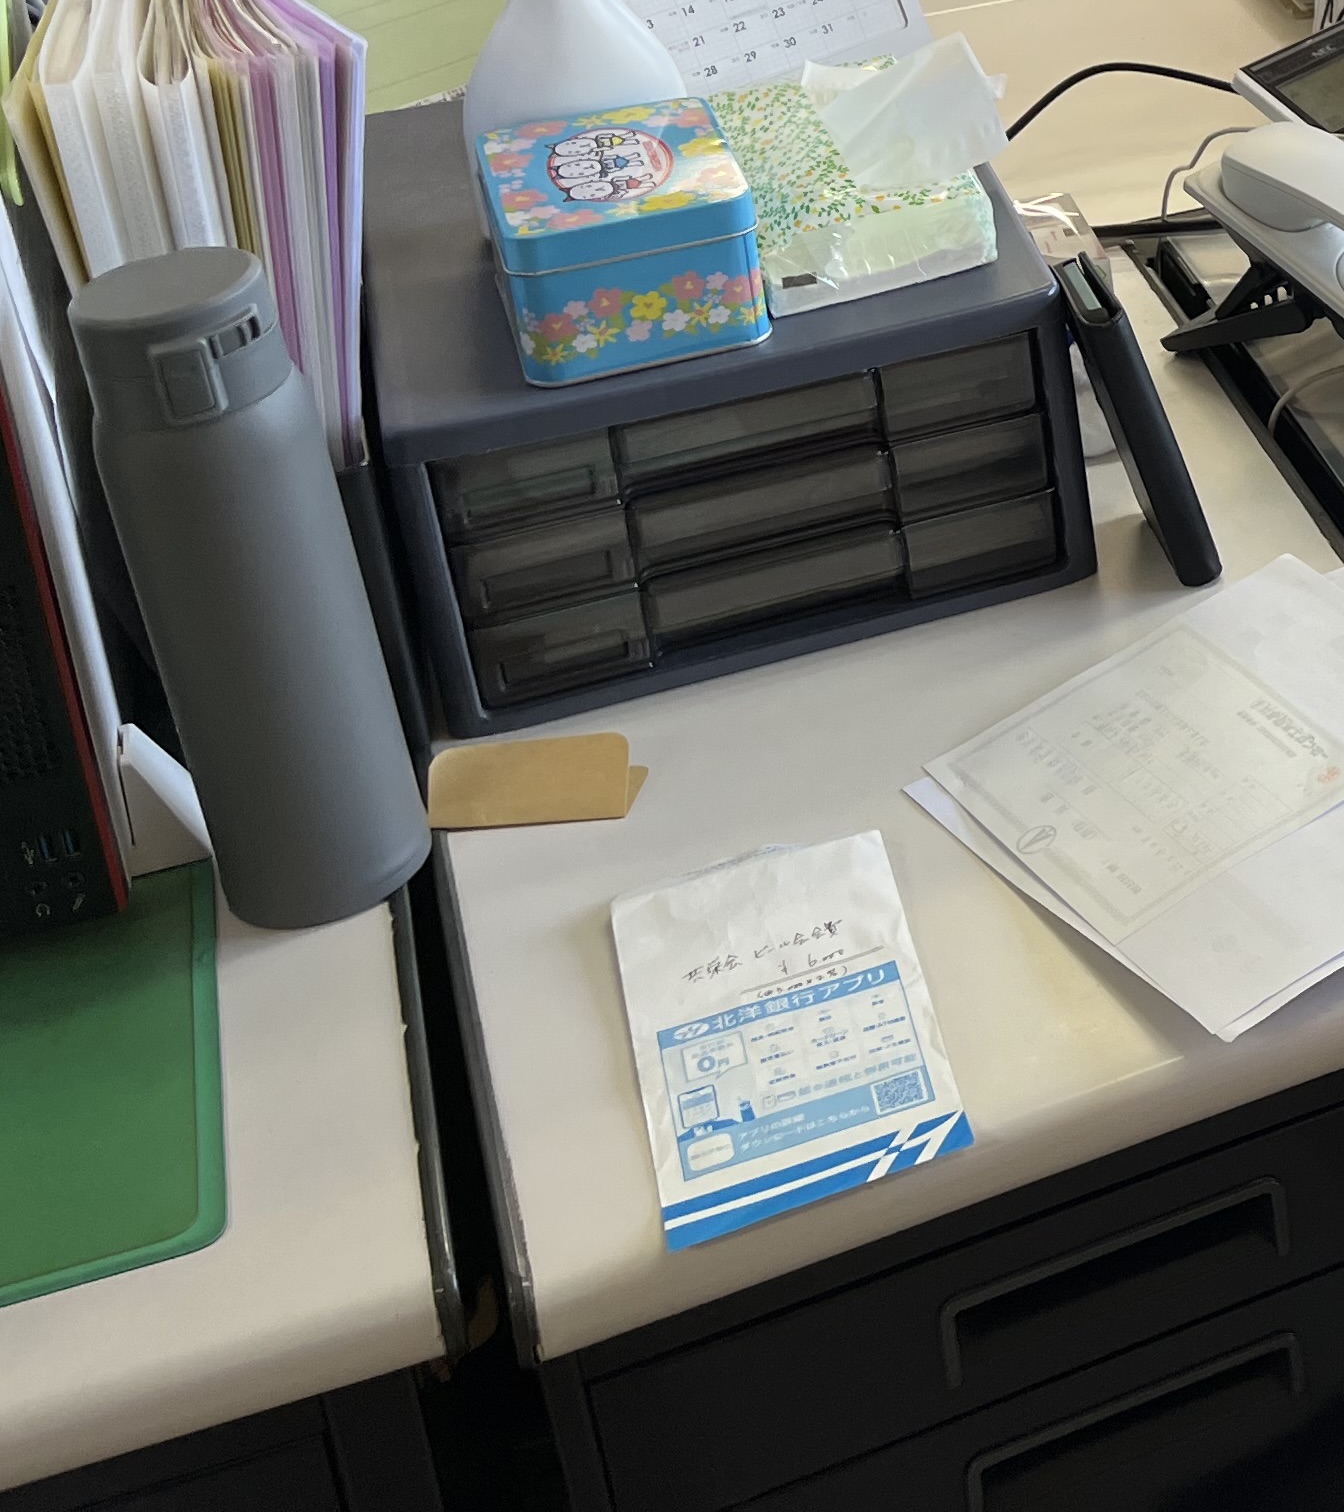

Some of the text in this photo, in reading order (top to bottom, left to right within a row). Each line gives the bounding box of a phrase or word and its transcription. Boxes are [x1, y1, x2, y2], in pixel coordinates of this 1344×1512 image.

[681, 5, 695, 16] 14
[772, 7, 785, 19] 23
[693, 21, 746, 47] 21 22
[784, 24, 834, 49] 30 31
[1312, 43, 1336, 56] NEC
[704, 51, 757, 77] 28 29
[712, 969, 885, 1030] 北洋銀行アプリ
